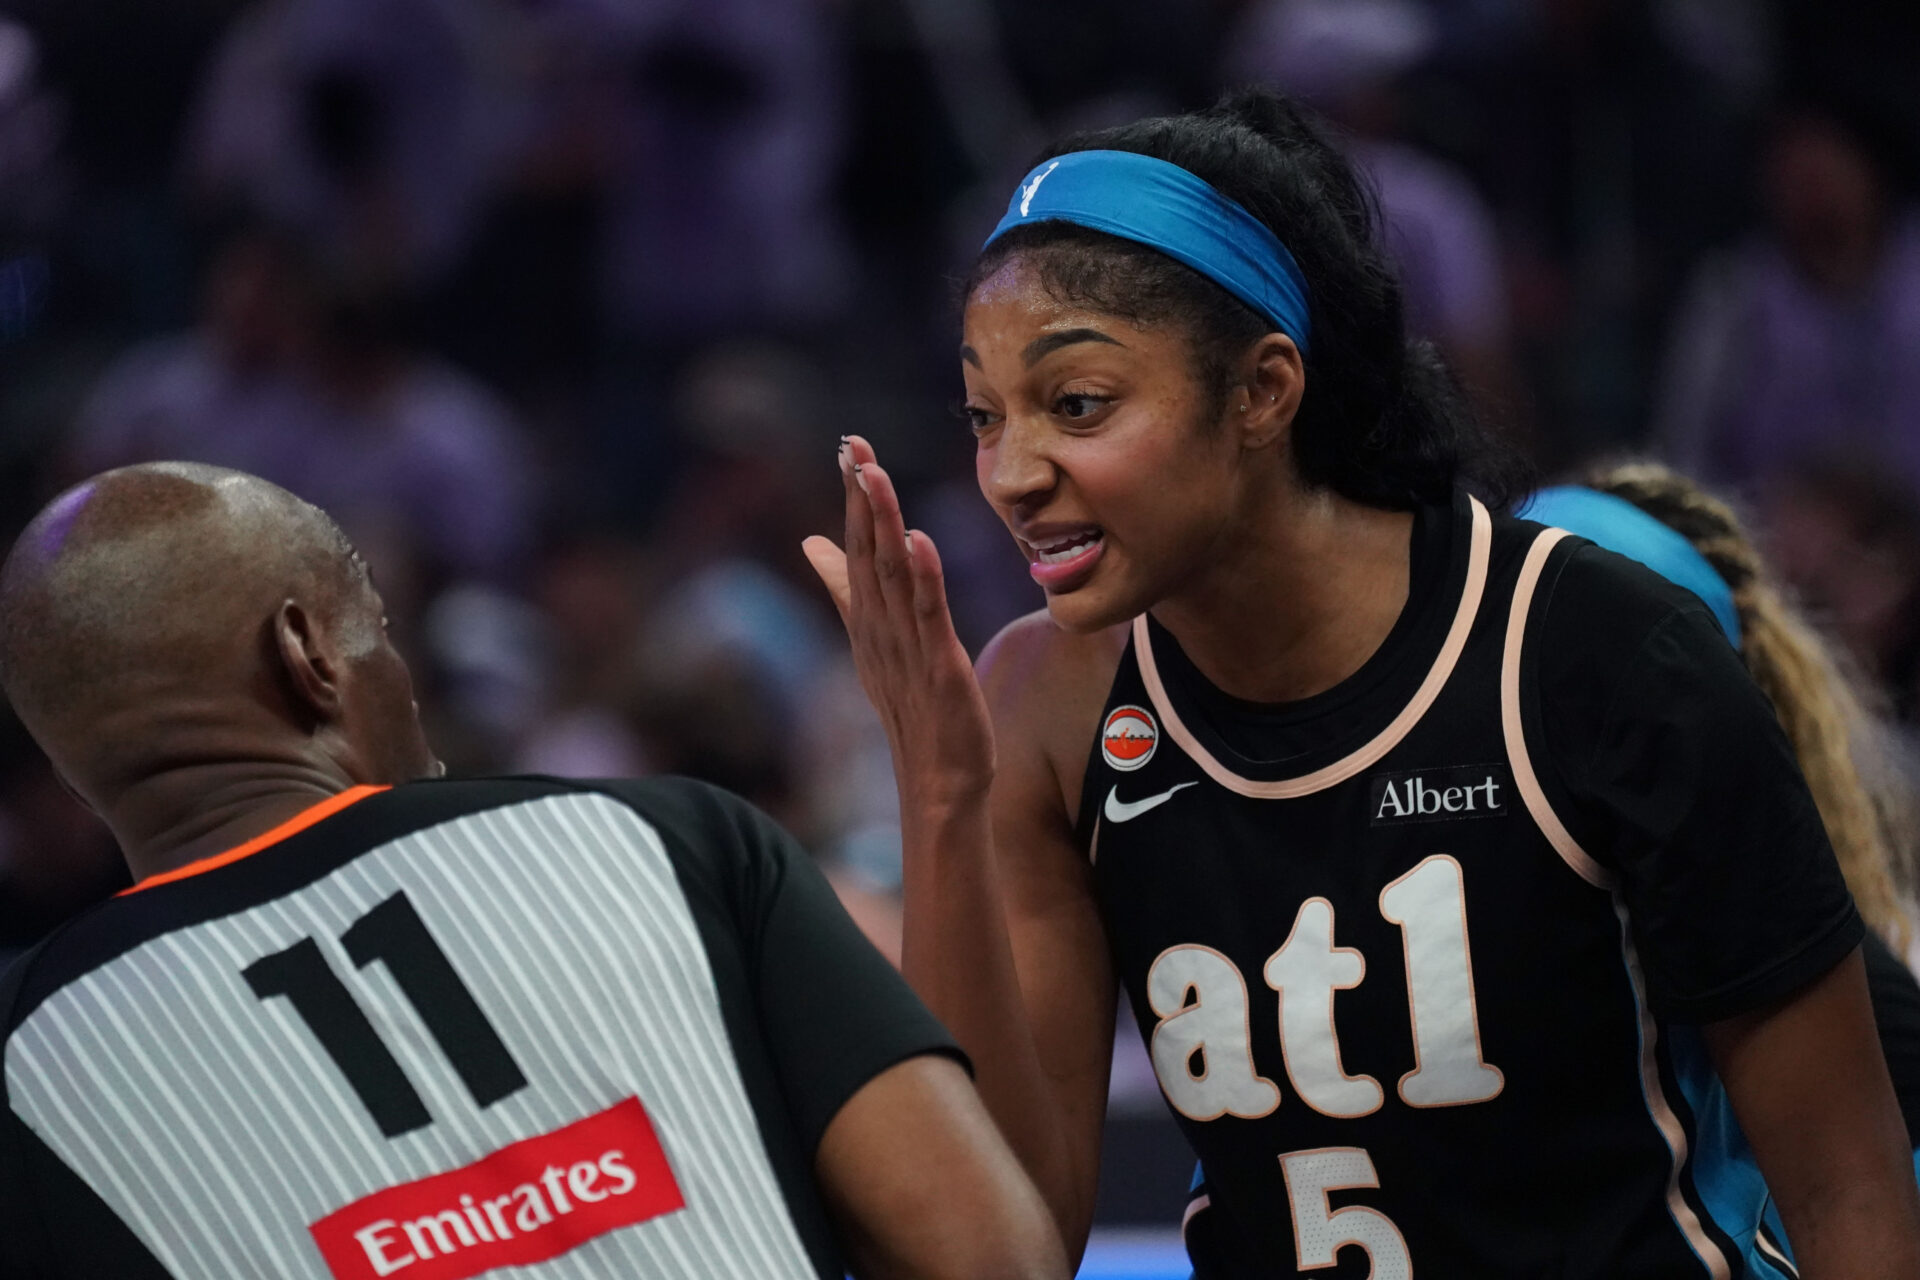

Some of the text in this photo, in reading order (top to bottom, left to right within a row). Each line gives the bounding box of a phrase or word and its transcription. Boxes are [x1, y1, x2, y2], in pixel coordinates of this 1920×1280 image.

[1376, 776, 1501, 818] Albert
[240, 889, 529, 1140] 11
[353, 1149, 637, 1277] Emirates
[1277, 1146, 1414, 1280] 5
